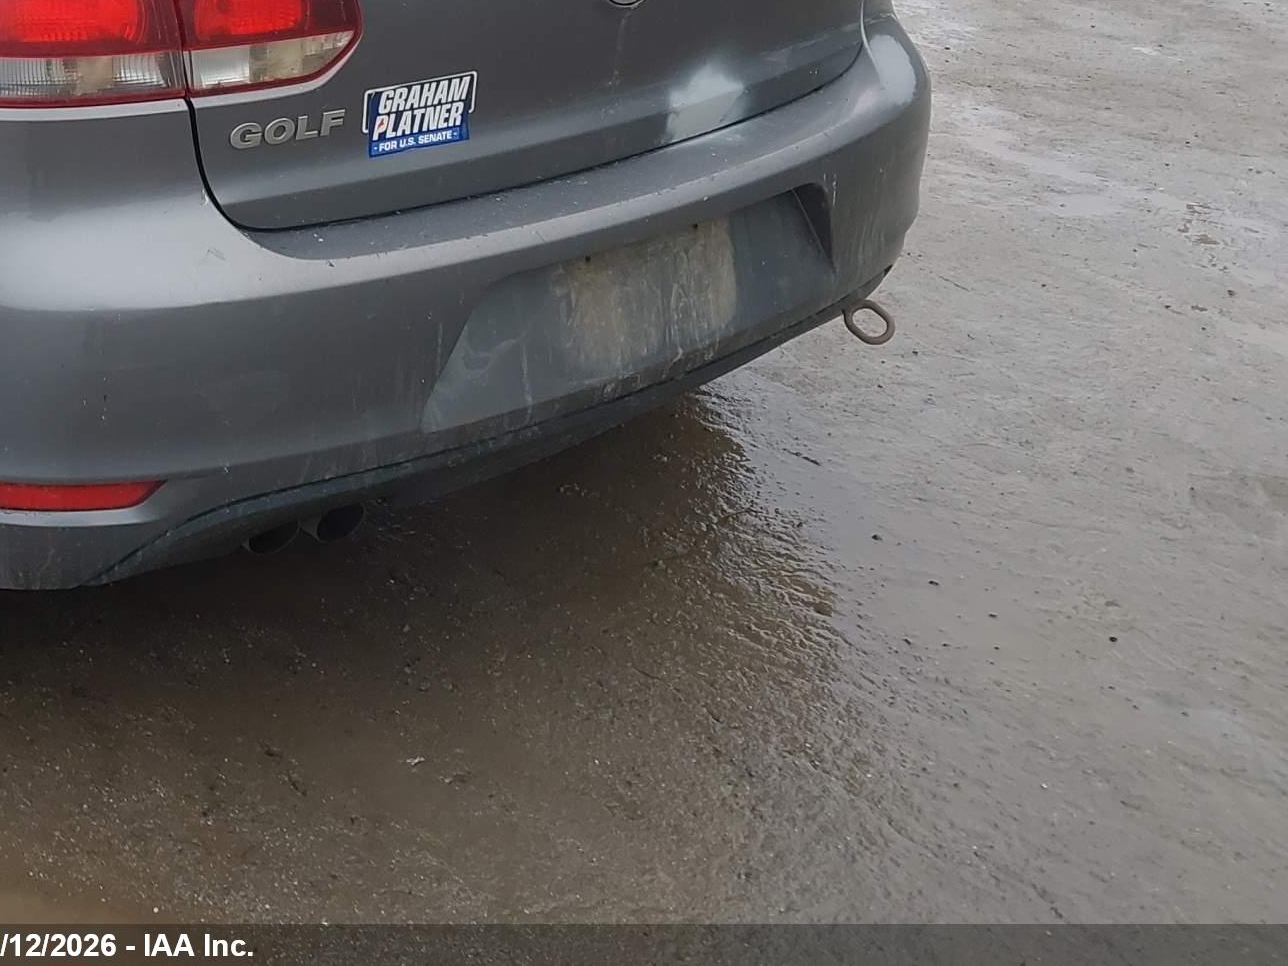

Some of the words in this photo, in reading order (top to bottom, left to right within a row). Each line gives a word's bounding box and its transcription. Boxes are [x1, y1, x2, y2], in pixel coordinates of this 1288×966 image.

[378, 76, 471, 114] GRAHAM
[230, 109, 346, 149] GOLF
[372, 101, 464, 141] PLATNER
[379, 140, 397, 152] FOR
[399, 137, 416, 149] U.S.
[418, 130, 453, 145] SENATE
